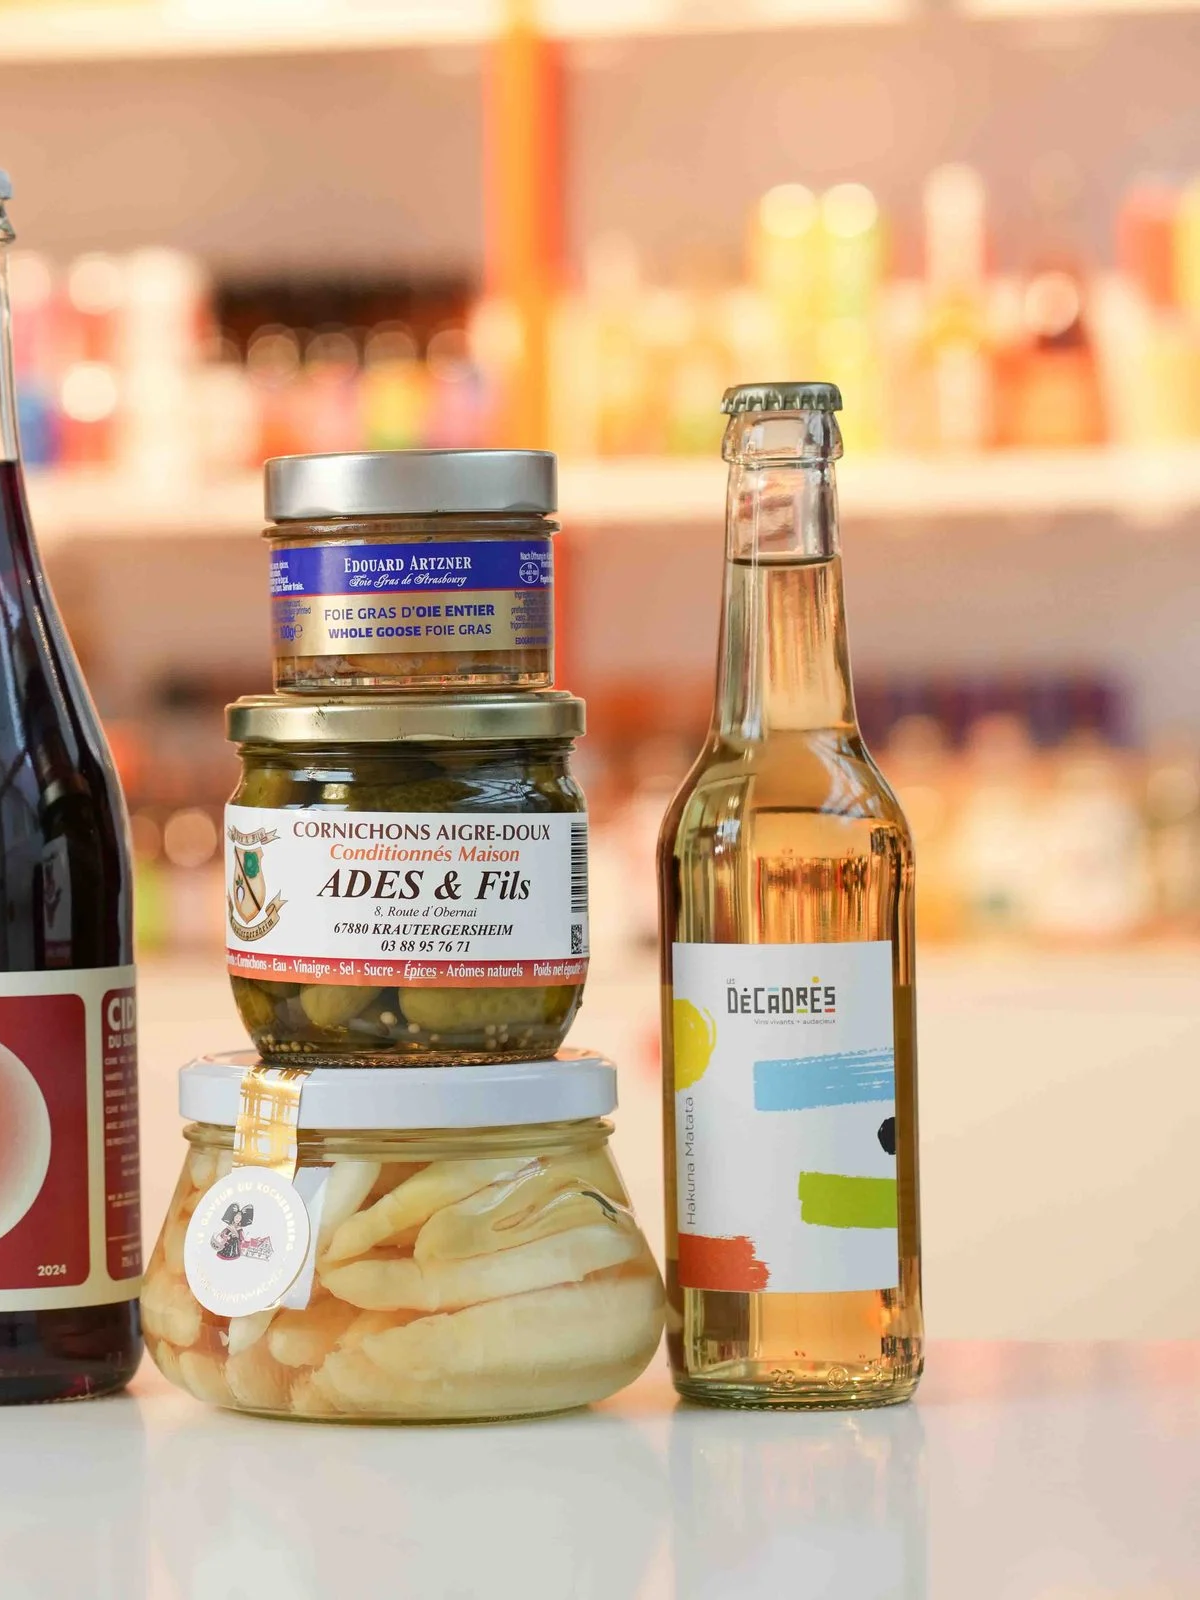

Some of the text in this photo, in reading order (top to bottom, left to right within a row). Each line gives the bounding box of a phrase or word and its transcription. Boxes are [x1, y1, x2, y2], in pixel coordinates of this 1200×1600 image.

[344, 555, 472, 573] EDOUARD ARTZNER
[349, 571, 467, 588] Foie Gras de Strasbourg
[324, 604, 495, 621] FOIE GRAS D'OIE ENTIER
[328, 624, 492, 639] WHOLE GOOSE FOIE GRAS
[293, 821, 551, 841] CORNICHONS AIGRE-DOUX
[330, 843, 520, 862] Conditionnés Maison
[317, 868, 531, 901] ADES & Fils
[374, 905, 384, 918] 8,
[388, 906, 419, 918] Route
[334, 922, 514, 936] 67880 KRAUTERGERSHEIM
[381, 940, 471, 953] 03 88 95 76 71
[272, 957, 287, 973] Eau
[293, 957, 330, 979] Vinaigre
[339, 961, 355, 976] Sel
[364, 962, 393, 977] Sucre
[403, 960, 437, 981] Épices
[446, 962, 485, 978] Arômes
[487, 962, 524, 978] naturels
[533, 962, 552, 977] Poids
[684, 1097, 696, 1226] Hakuna Matata
[37, 1264, 67, 1277] 2024
